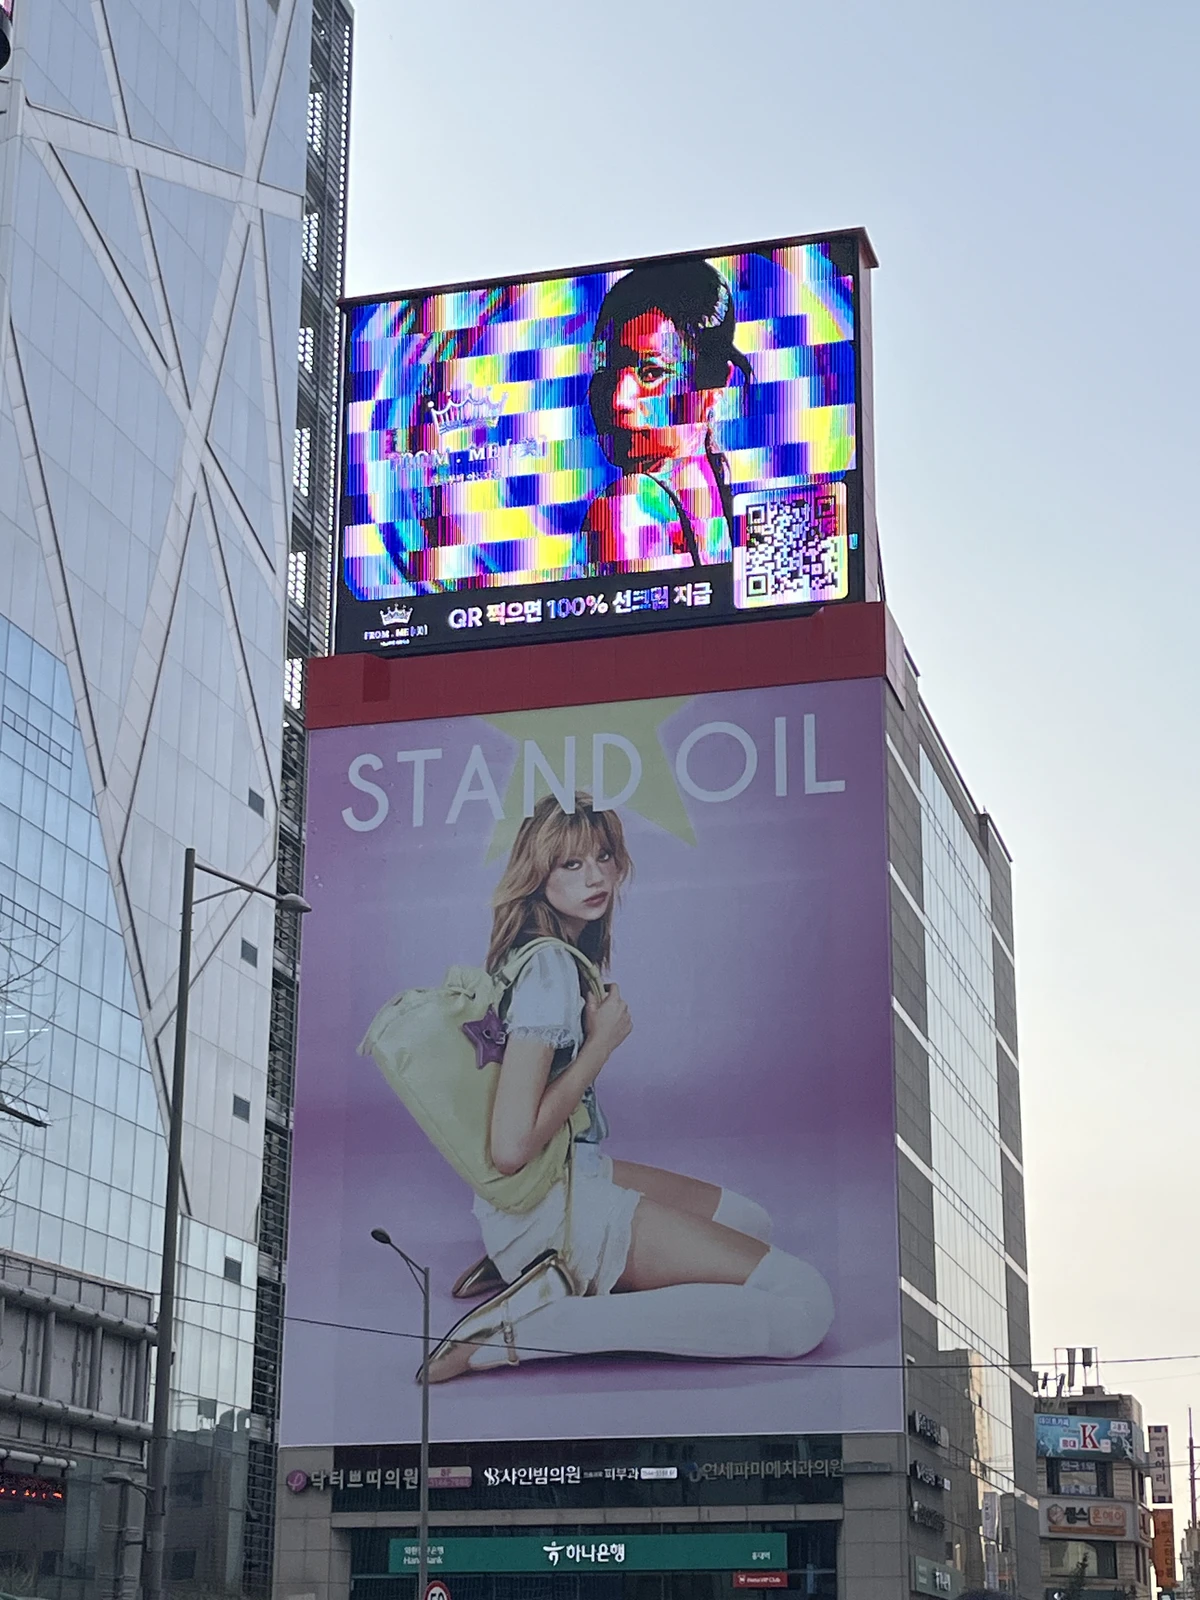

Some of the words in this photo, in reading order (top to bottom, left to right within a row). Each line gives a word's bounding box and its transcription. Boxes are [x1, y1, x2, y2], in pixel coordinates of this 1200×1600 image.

[448, 607, 482, 629] QR
[546, 593, 609, 619] 100%
[673, 582, 713, 607] 지급
[340, 733, 643, 832] STAND
[675, 714, 846, 804] OIL
[1080, 1424, 1099, 1449] K
[501, 1465, 581, 1486] 샤인빔의원
[604, 1467, 640, 1481] 피부과
[702, 1459, 845, 1480] 연세파미에치과의원
[566, 1543, 626, 1563] 하나은행
